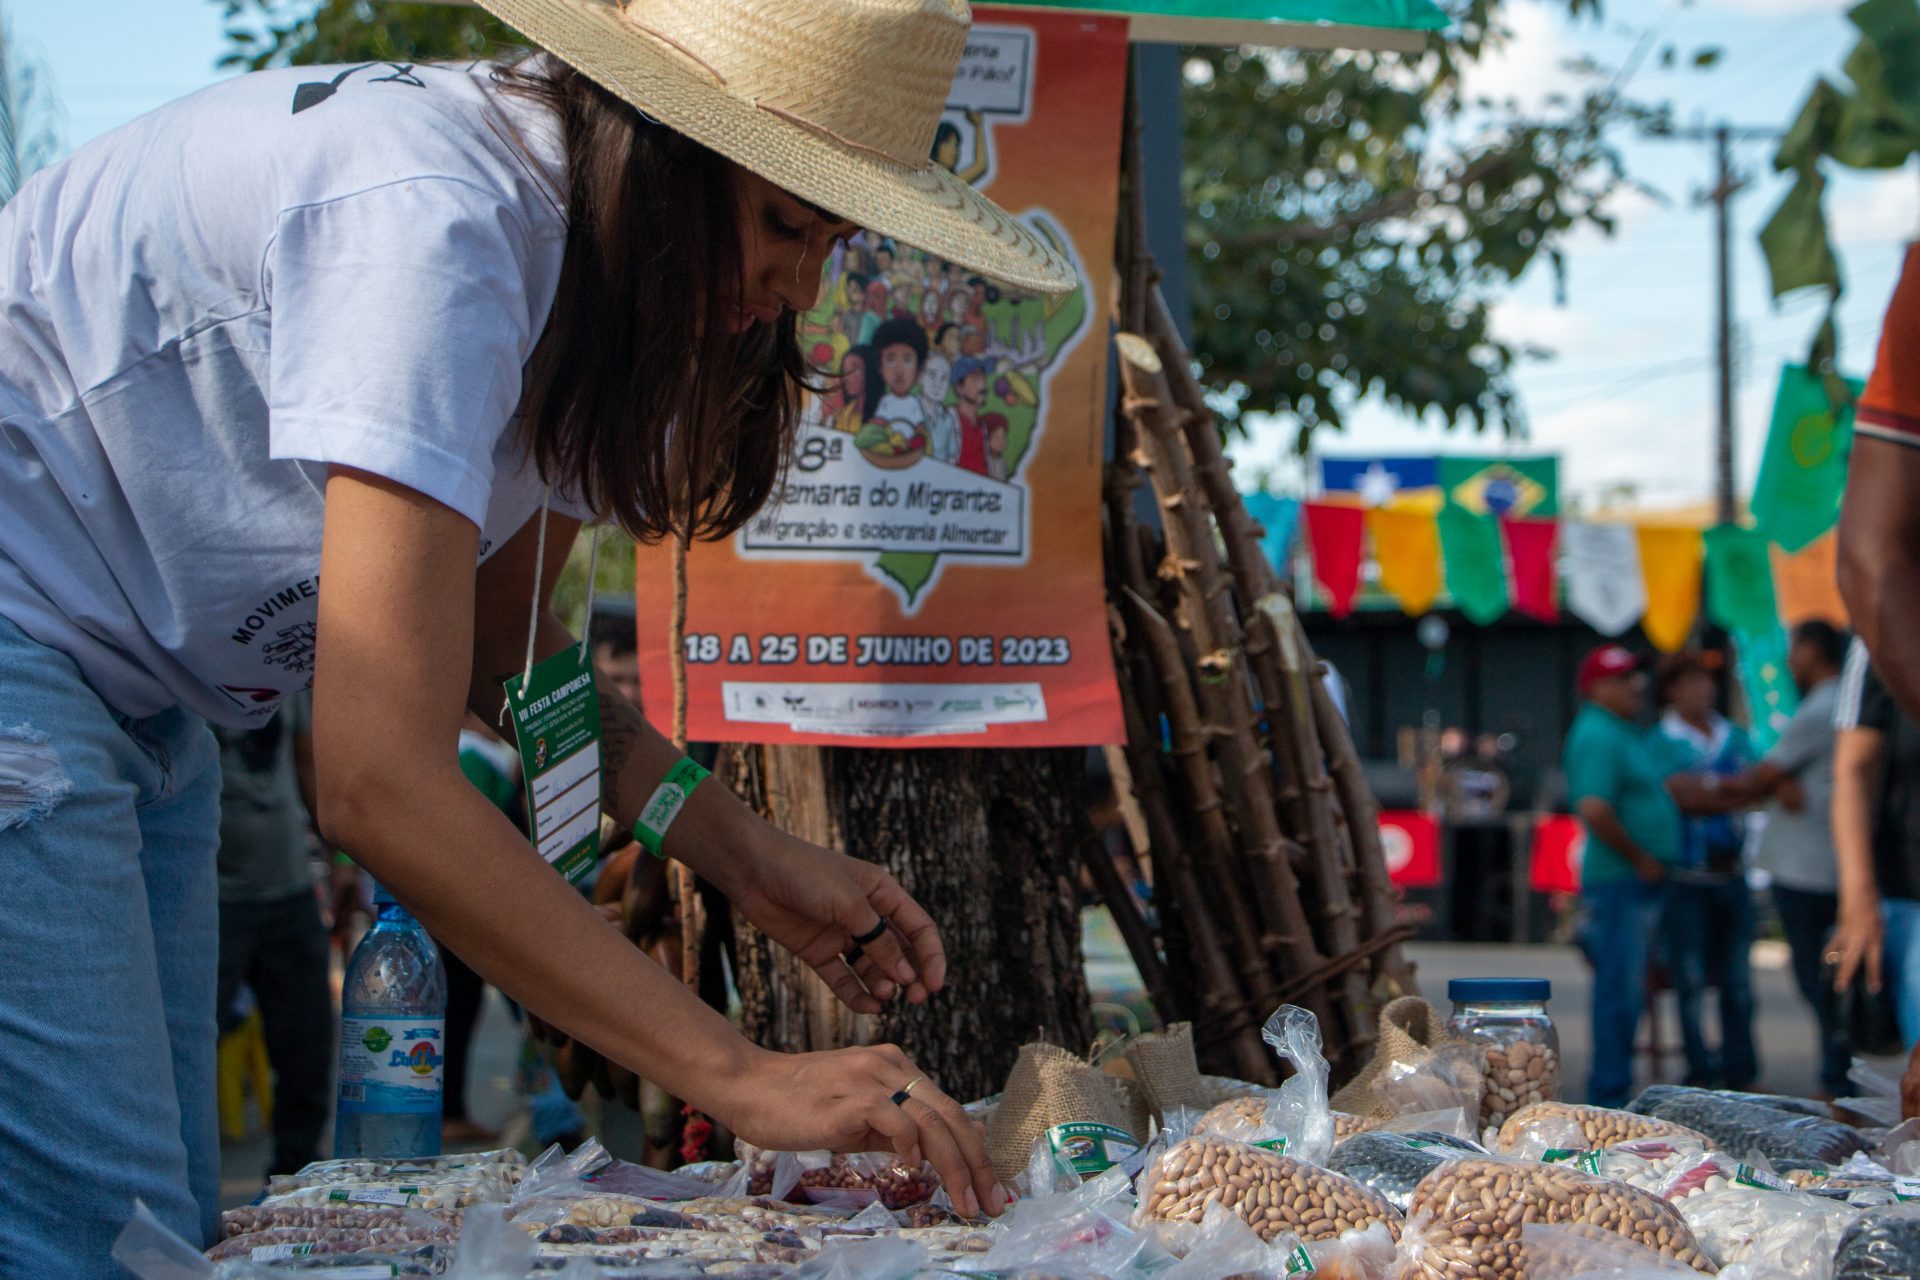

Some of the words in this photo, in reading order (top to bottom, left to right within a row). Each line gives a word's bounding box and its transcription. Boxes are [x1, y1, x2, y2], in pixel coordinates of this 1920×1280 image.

[796, 436, 844, 472] 8ª
[869, 480, 899, 508] do
[905, 482, 1003, 516] Migrante
[843, 522, 856, 540] e
[860, 521, 938, 543] soberania
[940, 522, 1010, 546] Alimentar
[231, 575, 320, 646] MOVIME
[685, 633, 721, 664] 18
[728, 633, 752, 664] A
[758, 634, 799, 664] 25
[807, 634, 849, 665] DE
[855, 634, 953, 666] JUNHO
[958, 635, 995, 666] DE
[1000, 635, 1071, 666] 2023
[529, 694, 552, 717] FESTA
[551, 671, 593, 704] CAMPONESA
[1069, 1125, 1104, 1133] FESTA
